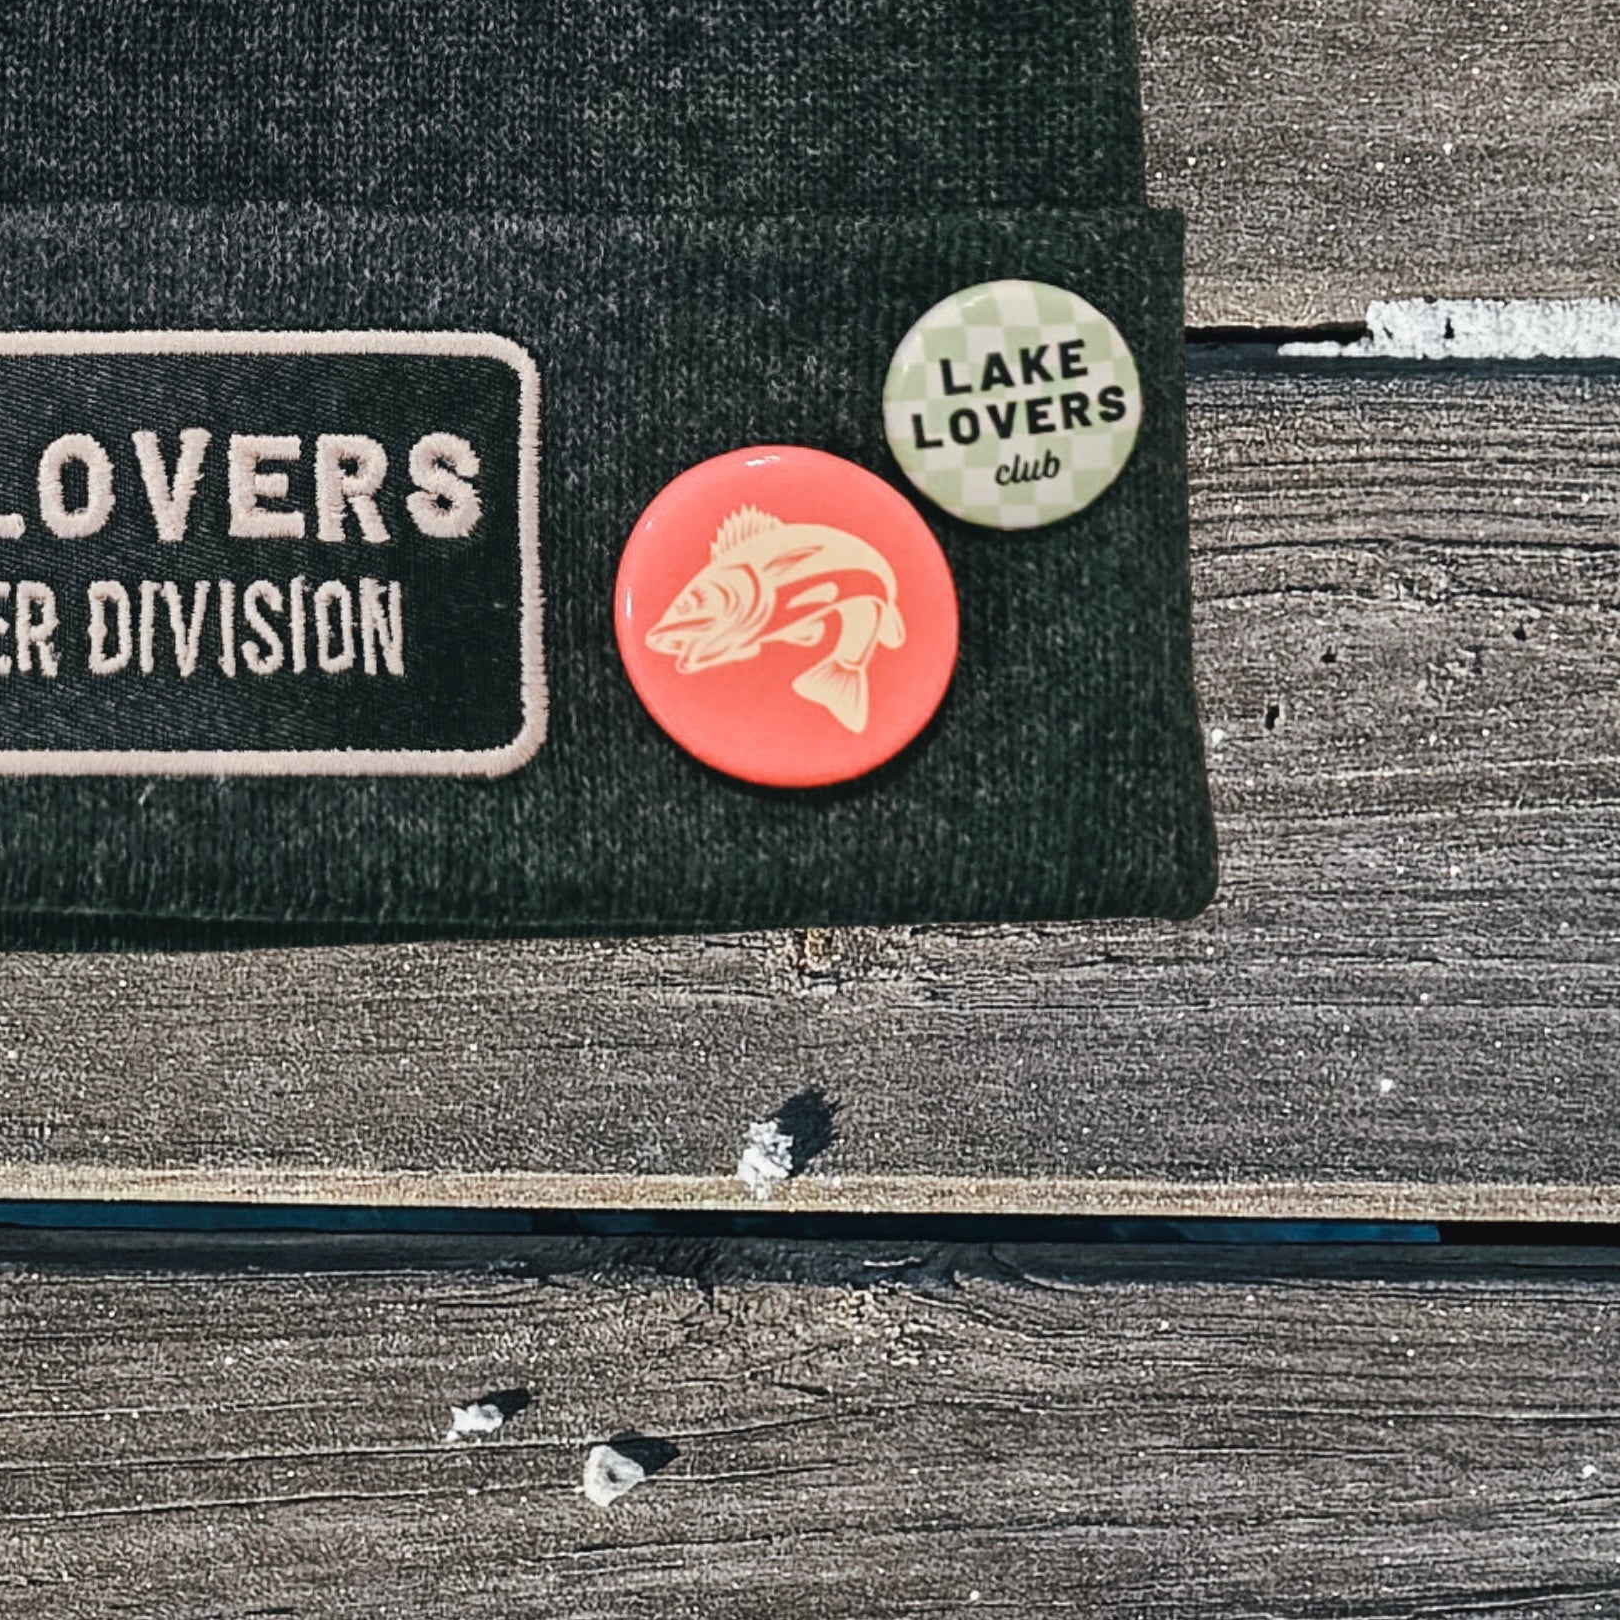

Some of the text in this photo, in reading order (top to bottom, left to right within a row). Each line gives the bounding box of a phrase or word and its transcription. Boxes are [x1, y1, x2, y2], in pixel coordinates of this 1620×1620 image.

[940, 339, 1088, 396] LAKE
[912, 386, 1126, 449] LOVERS
[995, 450, 1060, 485] club
[87, 577, 406, 678] DIVISION
